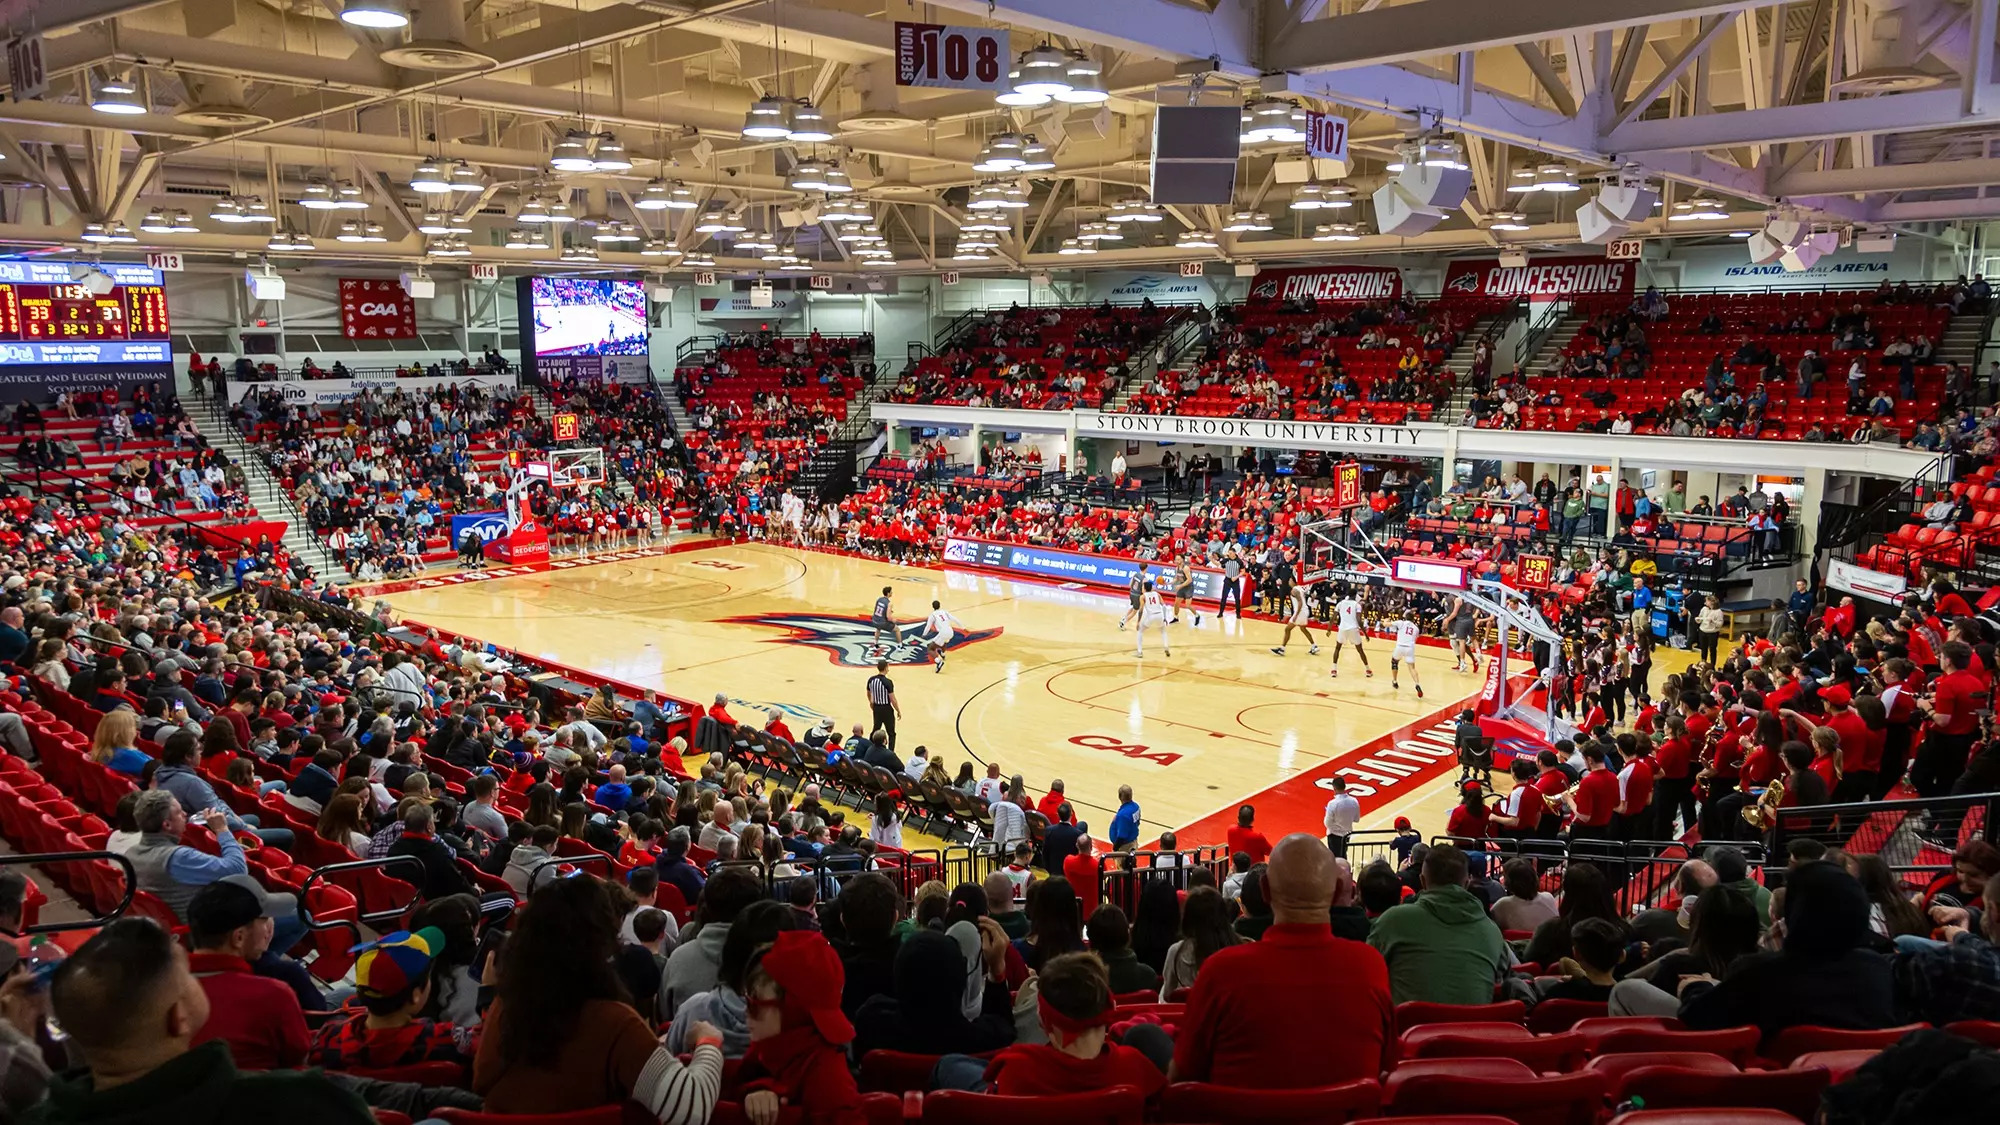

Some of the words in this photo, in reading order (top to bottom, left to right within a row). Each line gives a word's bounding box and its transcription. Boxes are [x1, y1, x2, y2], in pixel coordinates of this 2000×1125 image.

[900, 27, 914, 80] SECTION
[921, 30, 999, 83] 108
[15, 38, 42, 92] 109
[1306, 114, 1314, 152] SECTION
[1316, 117, 1345, 155] 107
[1612, 242, 1640, 256] 203
[157, 255, 178, 268] 113
[478, 266, 495, 278] 114
[1184, 263, 1201, 275] 202
[1725, 266, 1783, 276] ISLAND
[1780, 266, 1831, 275] FRAL
[1830, 262, 1888, 272] ARENA
[700, 274, 712, 284] 115
[1283, 271, 1396, 299] CONCESSIONS
[1485, 263, 1625, 295] CONCESSIONS
[56, 285, 92, 299] 11:39
[1112, 286, 1142, 295] ISLAND
[1167, 285, 1198, 293] ARENA
[30, 306, 49, 319] 33
[70, 307, 78, 319] 2
[102, 307, 121, 320] 37
[360, 302, 399, 316] CAA
[30, 323, 39, 335] 6
[47, 323, 56, 335] 3
[63, 323, 78, 335] 32
[80, 324, 89, 334] 4
[96, 323, 104, 335] 3
[113, 324, 122, 334] 4
[551, 359, 571, 367] ABOUT
[0, 374, 42, 383] EATRICE
[44, 374, 70, 382] AND
[72, 372, 113, 381] EUGENE
[115, 371, 168, 380] WEIDMAN
[350, 380, 397, 389] Ardolino.com
[240, 384, 307, 404] Arlino
[559, 424, 573, 437] 20
[1097, 415, 1164, 431] STONY
[1175, 419, 1251, 436] BROOK
[1264, 423, 1422, 445] UNIVERSITY
[1341, 481, 1355, 502] 20
[459, 525, 505, 541] SNY
[514, 545, 547, 555] REDEFINE
[1525, 569, 1542, 583] 20
[1148, 596, 1156, 605] 14
[1346, 606, 1351, 614] 4
[1405, 626, 1414, 635] 13
[1481, 656, 1500, 700] news12
[1067, 735, 1184, 766] CAA
[1313, 714, 1460, 797] WOLVES
